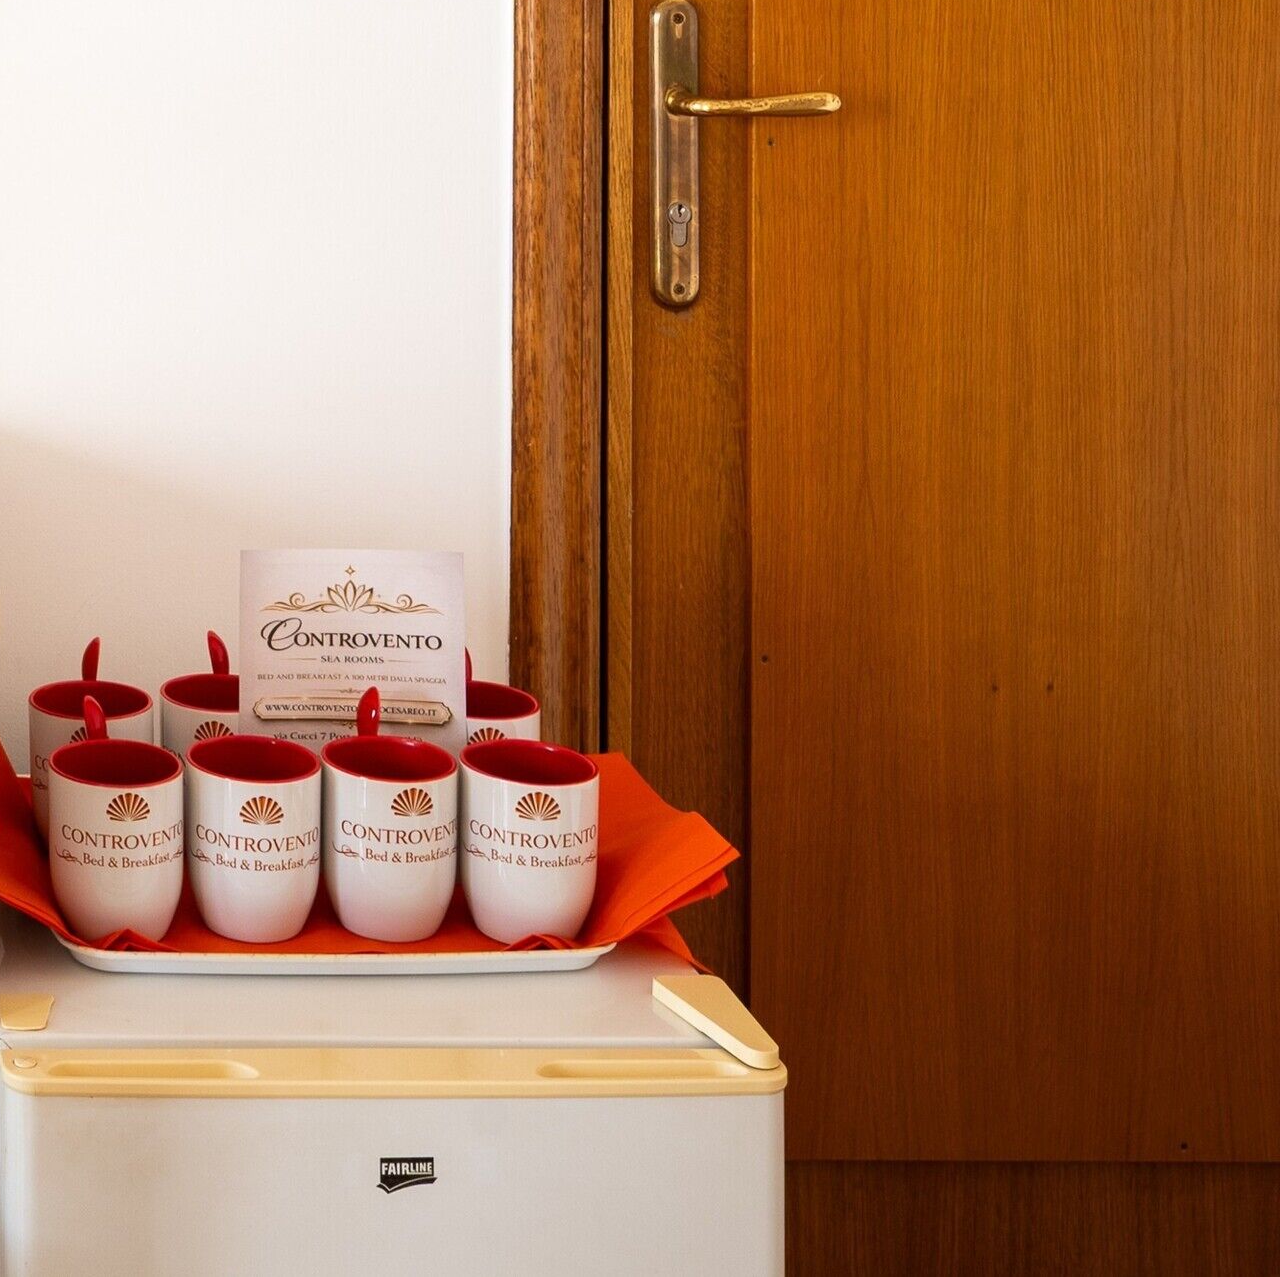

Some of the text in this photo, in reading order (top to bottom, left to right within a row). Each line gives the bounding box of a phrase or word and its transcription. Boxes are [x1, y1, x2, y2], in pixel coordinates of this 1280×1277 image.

[260, 617, 443, 651] CONTROVENTO
[321, 655, 385, 664] SEA ROOMS
[390, 675, 413, 683] DALLA
[414, 676, 447, 684] SPIAGGIA
[273, 731, 288, 740] via
[291, 731, 318, 740] Cucci
[320, 732, 327, 740] 7
[195, 823, 320, 854] CONTROVENTO
[469, 819, 597, 850] CONTROVENTO
[83, 852, 170, 869] Bed & Breakfast
[216, 853, 304, 872] Bed & Breakfast
[365, 847, 450, 864] Bed & Breakfast
[490, 848, 582, 869] Bed & Breakfast
[381, 1162, 433, 1176] FAIRLINE
